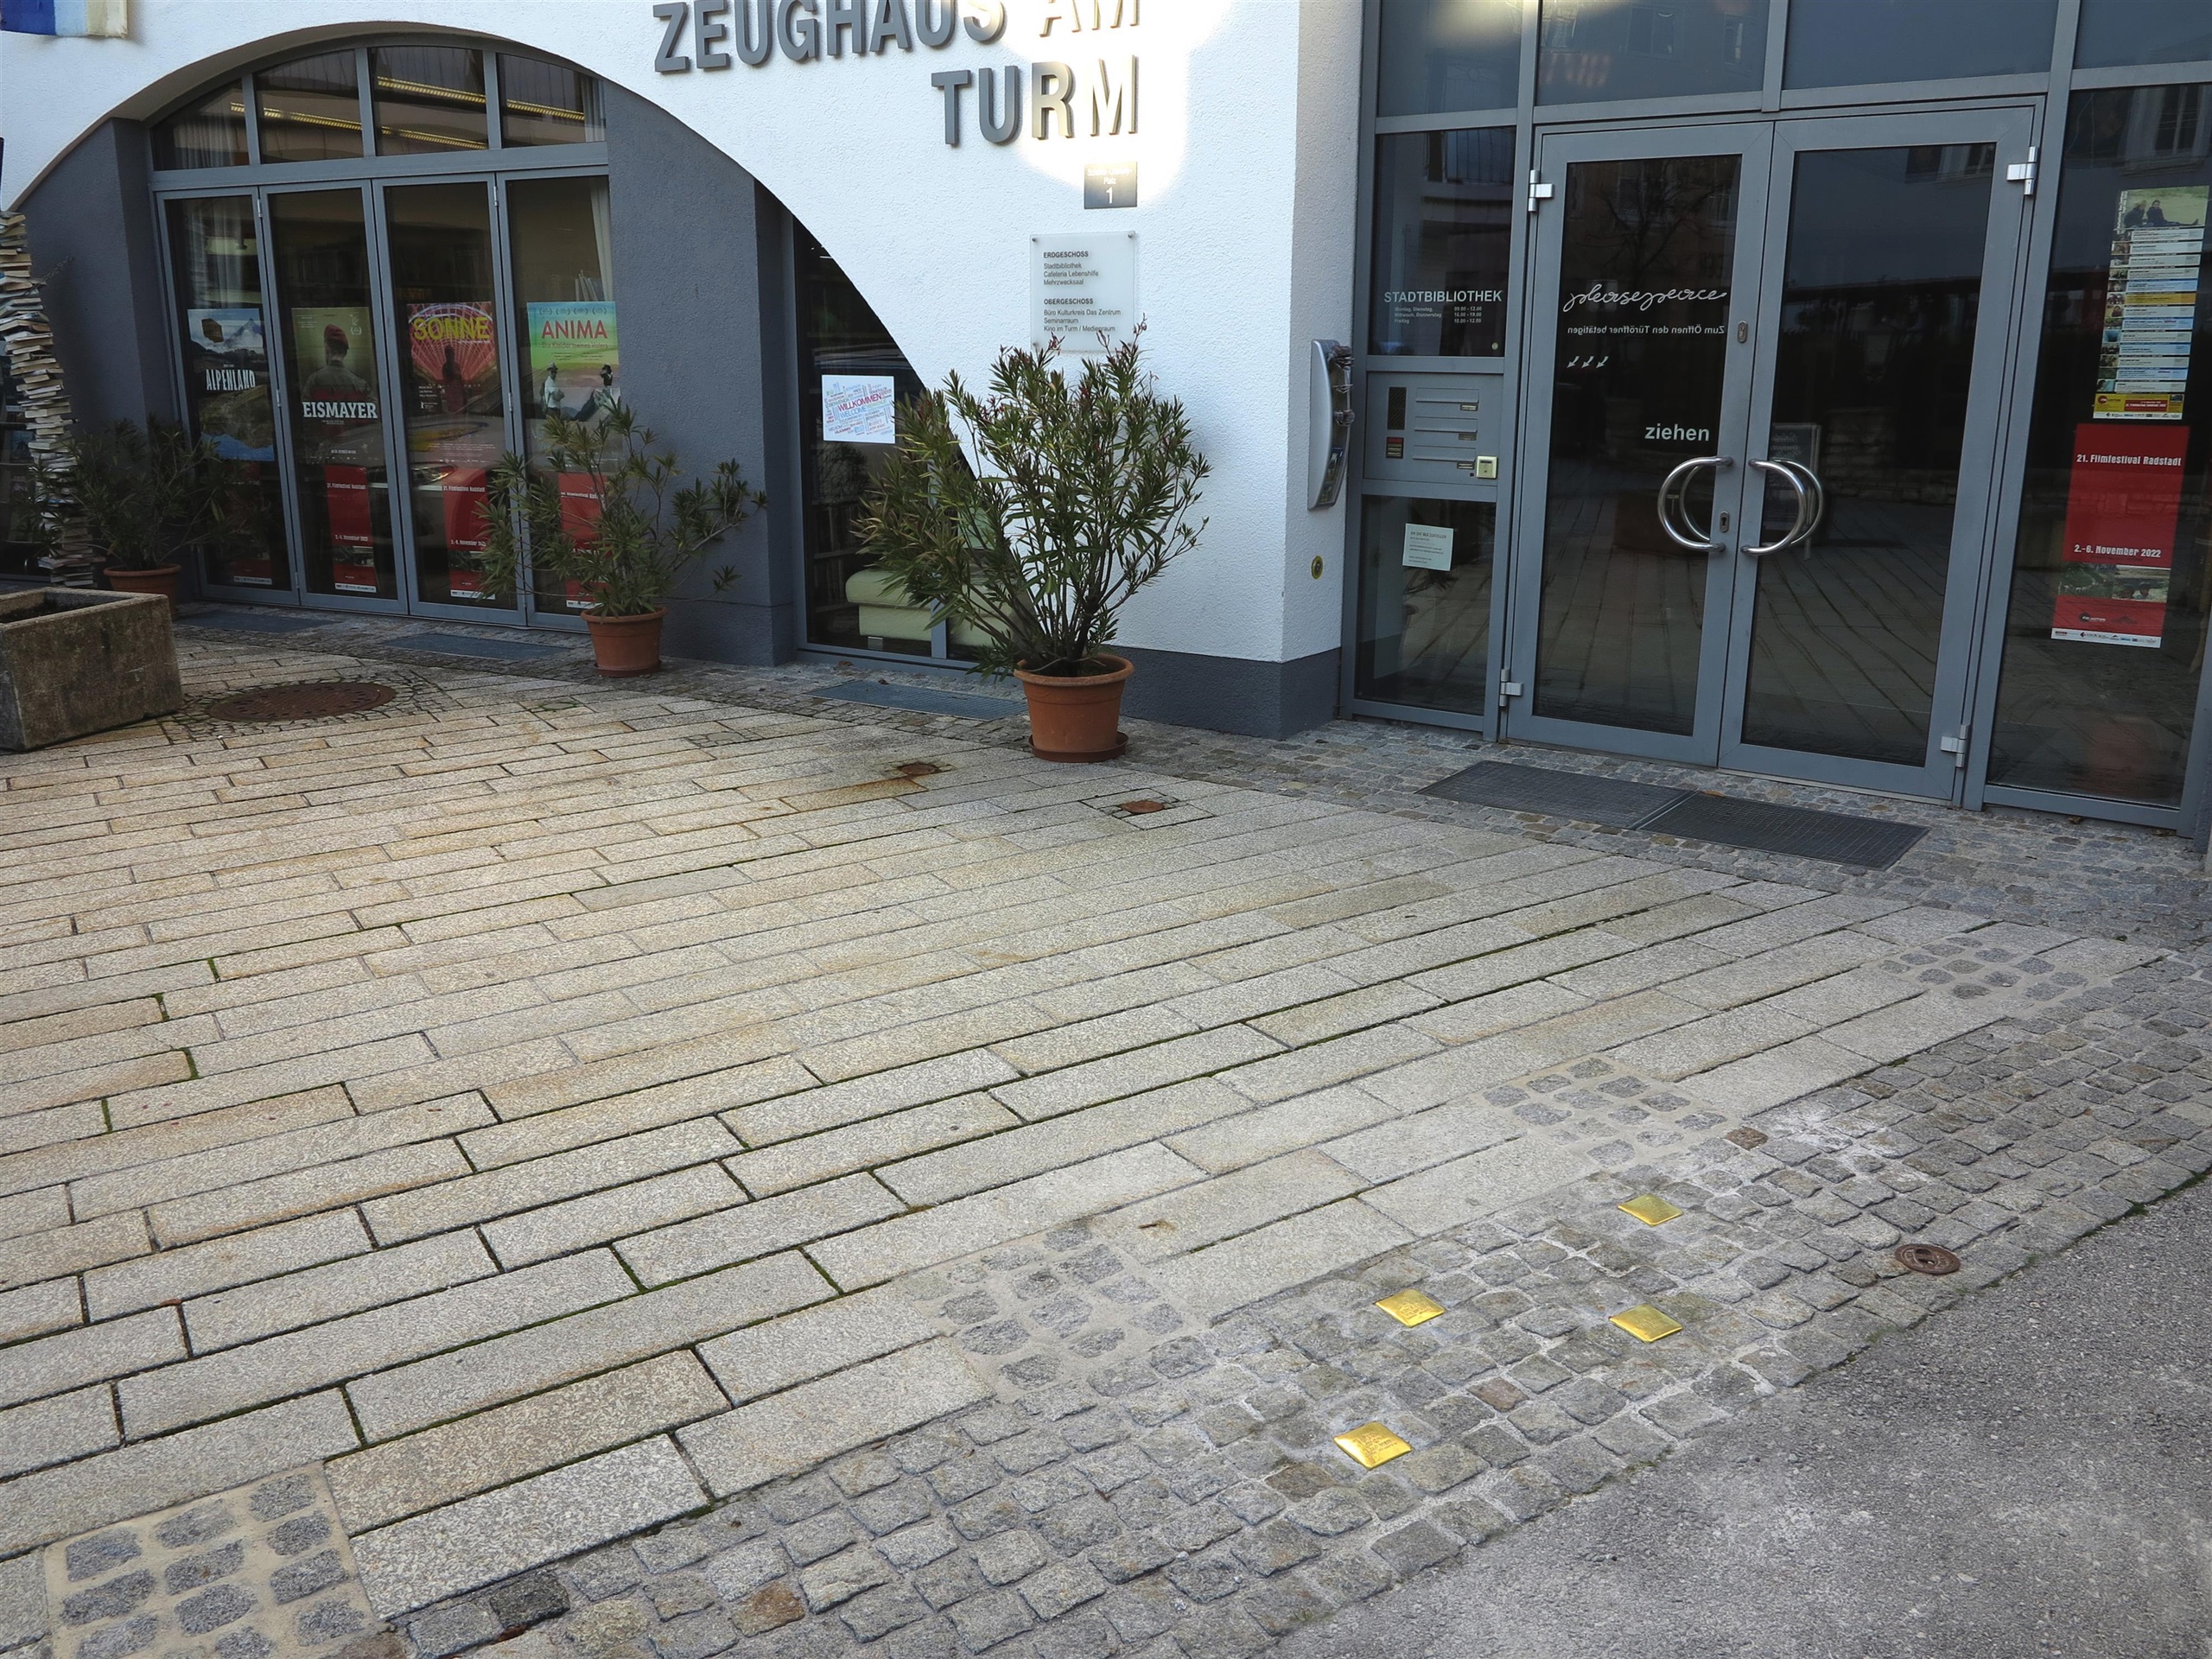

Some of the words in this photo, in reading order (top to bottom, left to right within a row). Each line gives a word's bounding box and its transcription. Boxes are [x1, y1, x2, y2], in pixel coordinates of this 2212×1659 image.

[653, 0, 1007, 74] ZEUGHAUS
[931, 55, 1139, 147] TURM
[1105, 187, 1114, 205] 1
[1383, 289, 1503, 303] STADTBIBLIOTHEK
[413, 316, 491, 340] SONNE
[542, 320, 607, 340] ANIMA
[206, 369, 256, 391] ALPENLAND
[302, 401, 378, 419] EISMAYER
[837, 393, 882, 411] WILLKOMMEN
[1644, 423, 1710, 441] ziehen
[2076, 454, 2088, 463] 21.
[2089, 454, 2141, 465] Filmfestival
[2143, 456, 2182, 467] Radstadt
[2095, 546, 2139, 556] November
[2140, 548, 2161, 557] 2022
